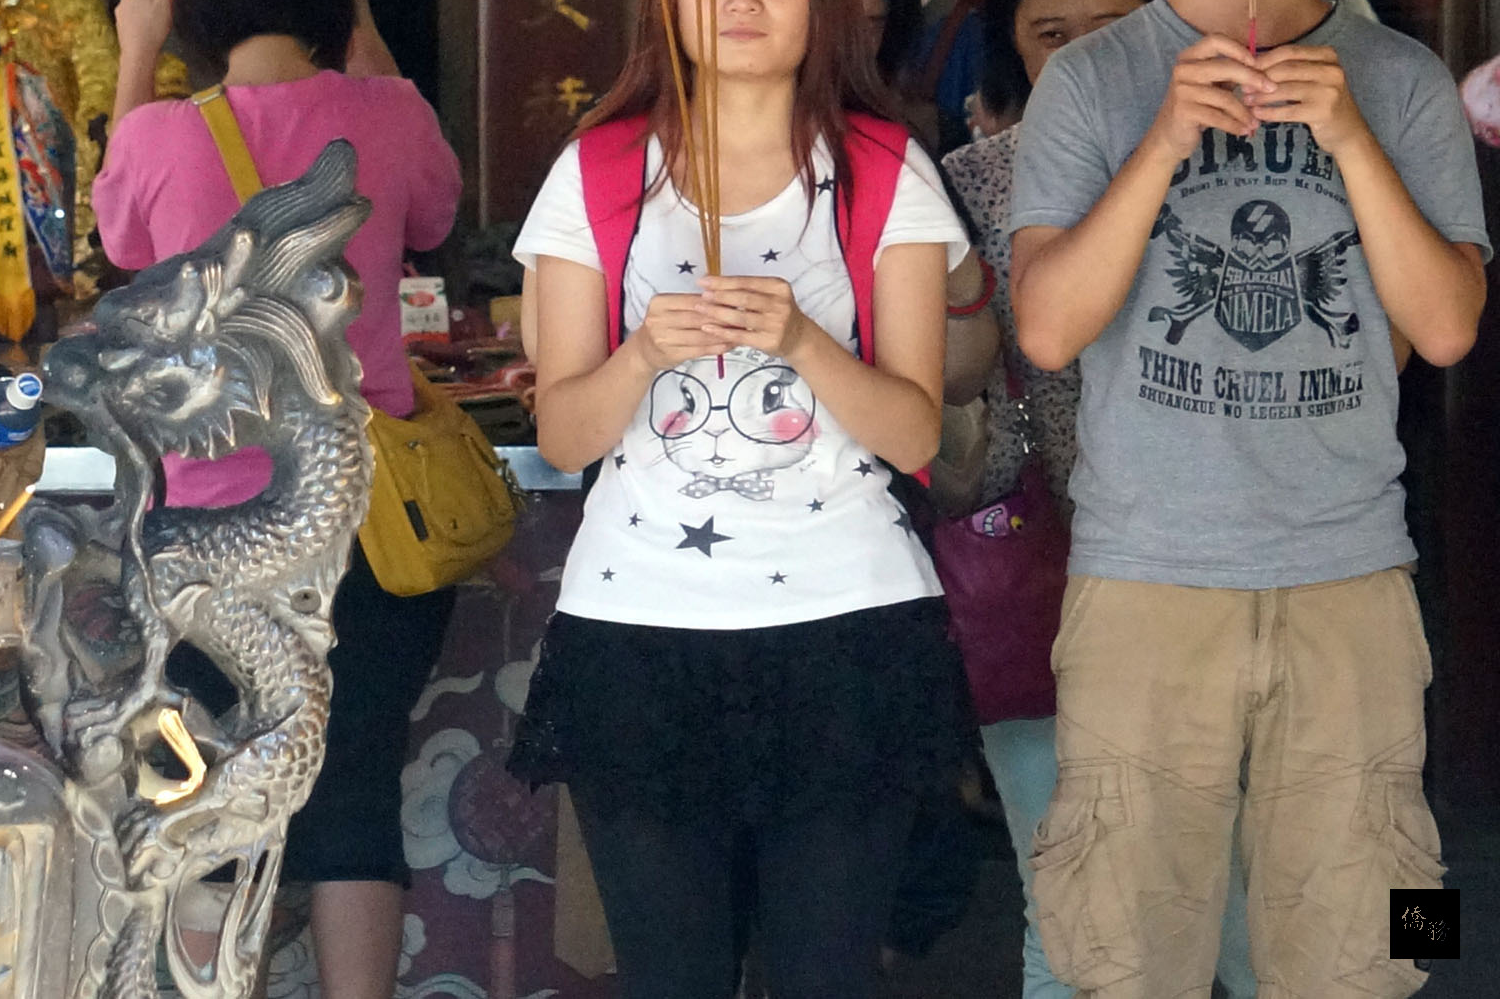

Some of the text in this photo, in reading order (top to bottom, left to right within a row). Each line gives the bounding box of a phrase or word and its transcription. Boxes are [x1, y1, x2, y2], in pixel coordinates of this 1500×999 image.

[1140, 346, 1202, 395] THING
[1214, 366, 1286, 403] CRUEL
[1139, 384, 1216, 415] SHUANGXUE
[1224, 403, 1242, 418] WO
